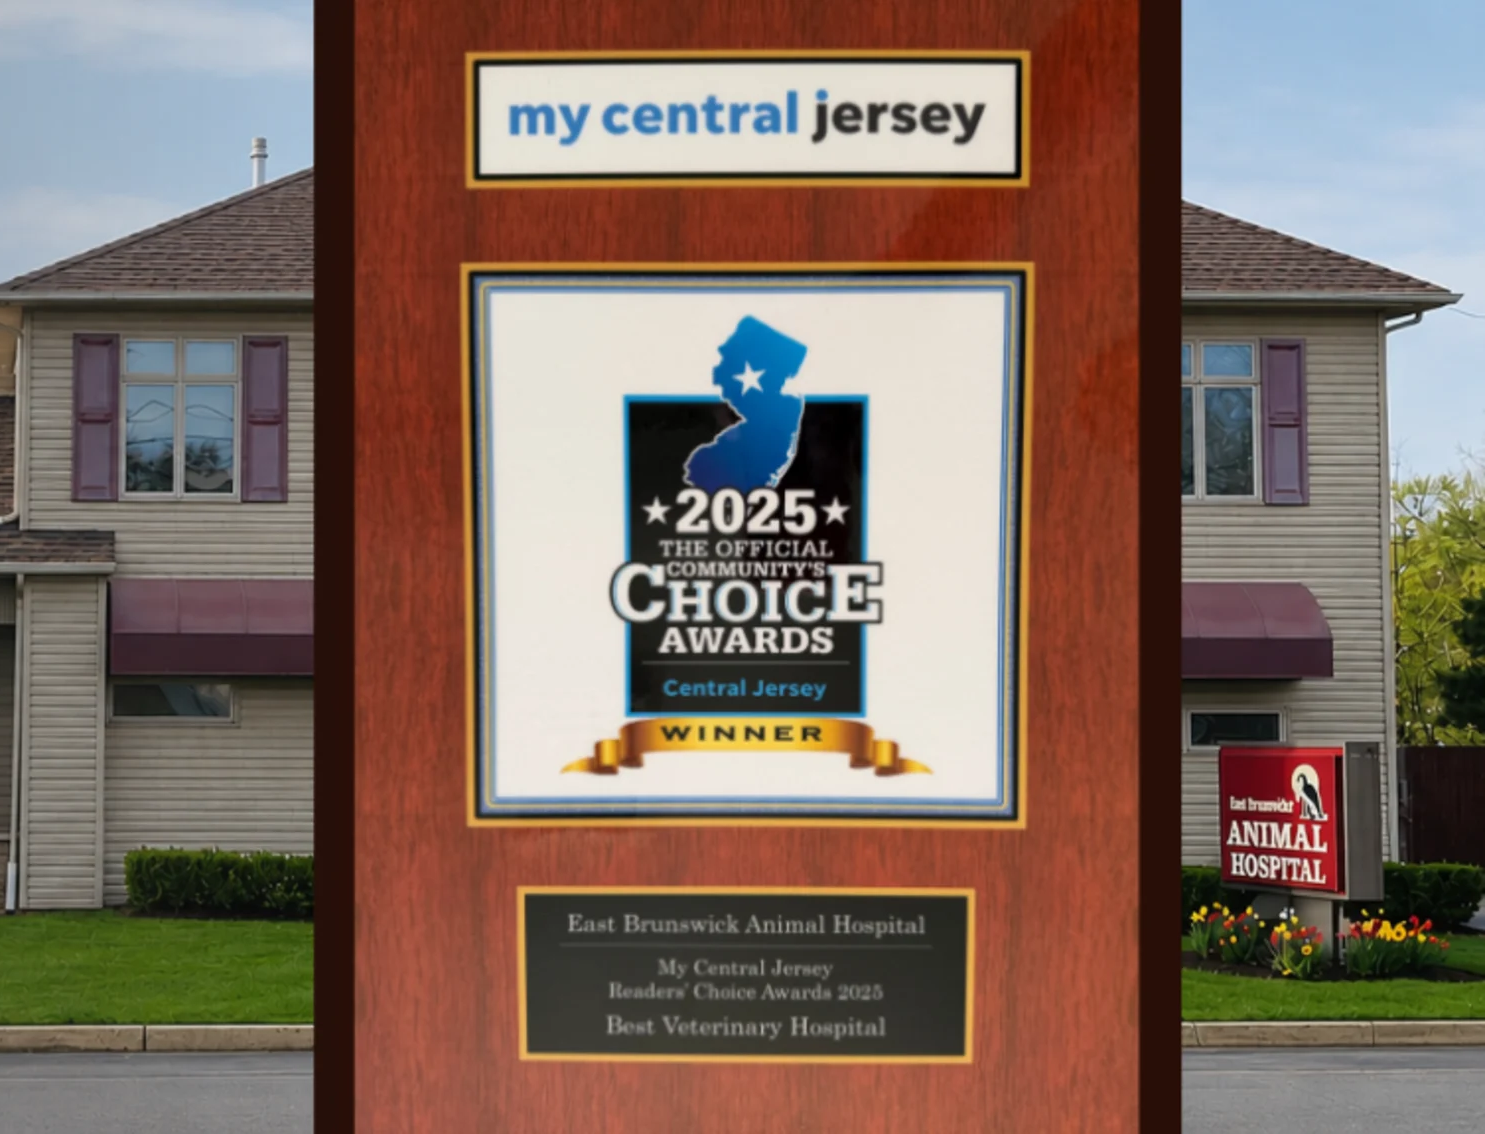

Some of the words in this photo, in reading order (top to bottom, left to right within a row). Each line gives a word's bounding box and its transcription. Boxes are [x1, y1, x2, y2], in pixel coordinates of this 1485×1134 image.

[509, 102, 591, 146] my
[601, 90, 798, 135] central
[811, 89, 986, 145] jersey
[675, 488, 817, 534] 2025
[659, 540, 708, 558] THE
[715, 540, 834, 558] OFFICIAL
[666, 561, 826, 577] COMMUNITY'S
[611, 561, 884, 624] CHOICE
[658, 627, 834, 654] AWARDS
[662, 678, 747, 698] Central
[752, 679, 827, 701] Jersey
[659, 725, 824, 743] WINNER
[1226, 820, 1328, 852] ANIMAL
[1230, 852, 1326, 884] HOSPITAL
[567, 914, 617, 934] East
[623, 914, 740, 935] Brunswick
[744, 915, 826, 935] Animal
[832, 916, 926, 939] Hospital
[657, 959, 688, 977] My
[693, 959, 765, 976] Central
[771, 960, 834, 979] Jersey
[608, 983, 690, 1001] Readers'
[693, 983, 756, 1001] Choice
[760, 985, 832, 1001] Awards
[837, 984, 884, 1001] 2025
[606, 1015, 655, 1035] Best
[661, 1016, 783, 1039] Veterinary
[789, 1017, 887, 1041] Hospital
